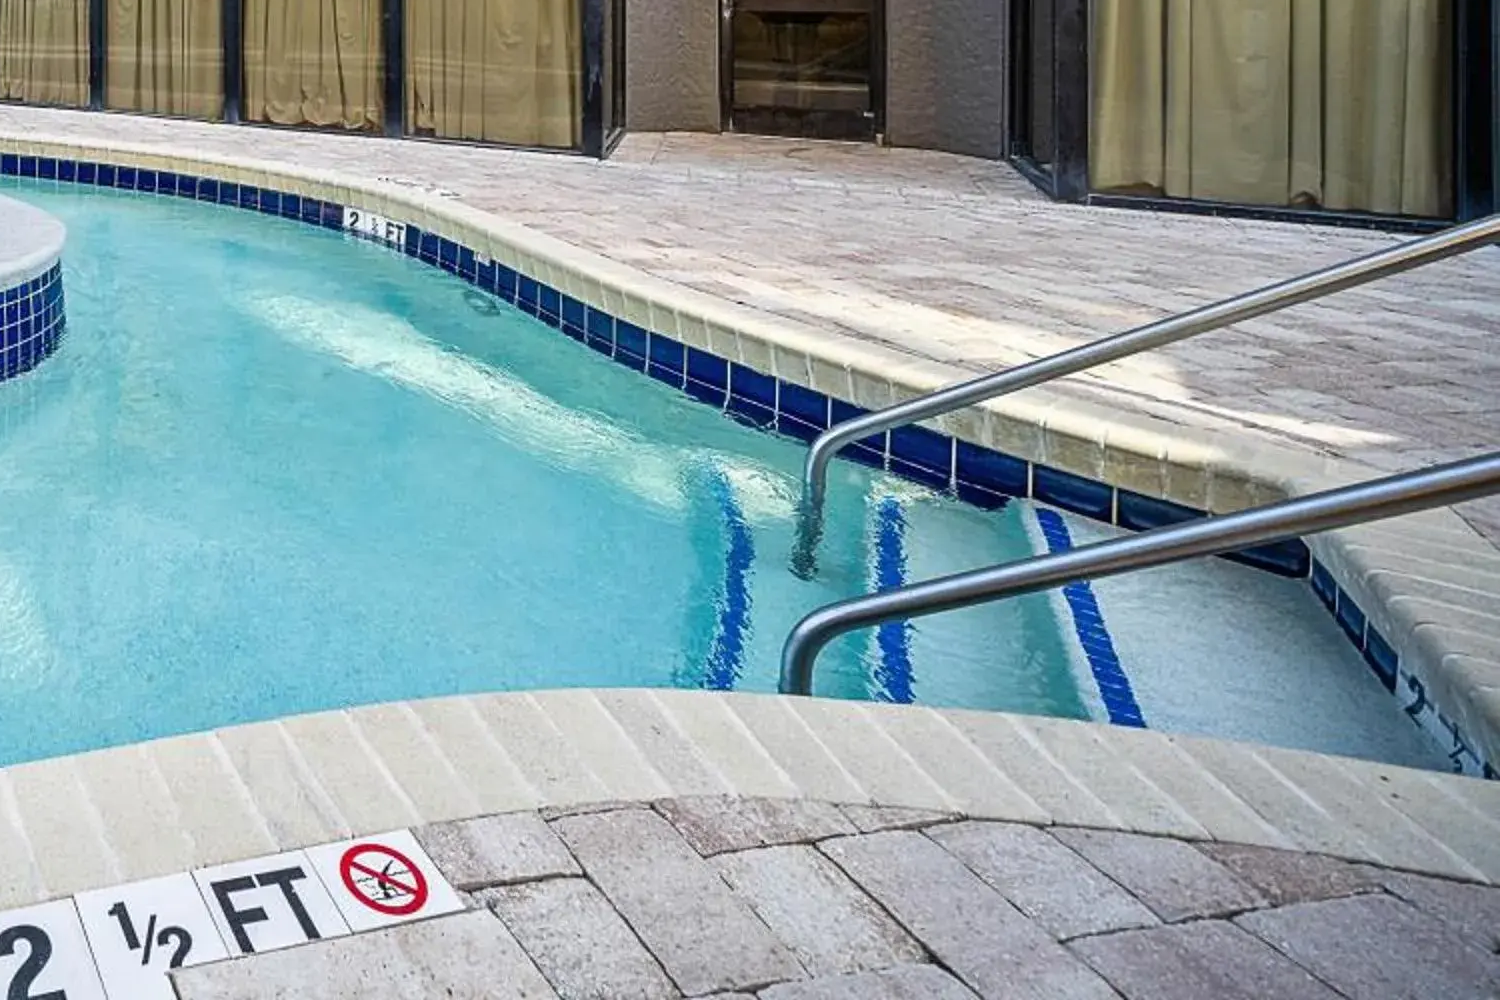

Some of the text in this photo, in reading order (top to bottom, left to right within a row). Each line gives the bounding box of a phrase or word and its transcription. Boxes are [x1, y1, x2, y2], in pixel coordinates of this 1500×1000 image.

[349, 211, 360, 228] 2
[385, 221, 405, 244] FT
[210, 866, 322, 953] FT
